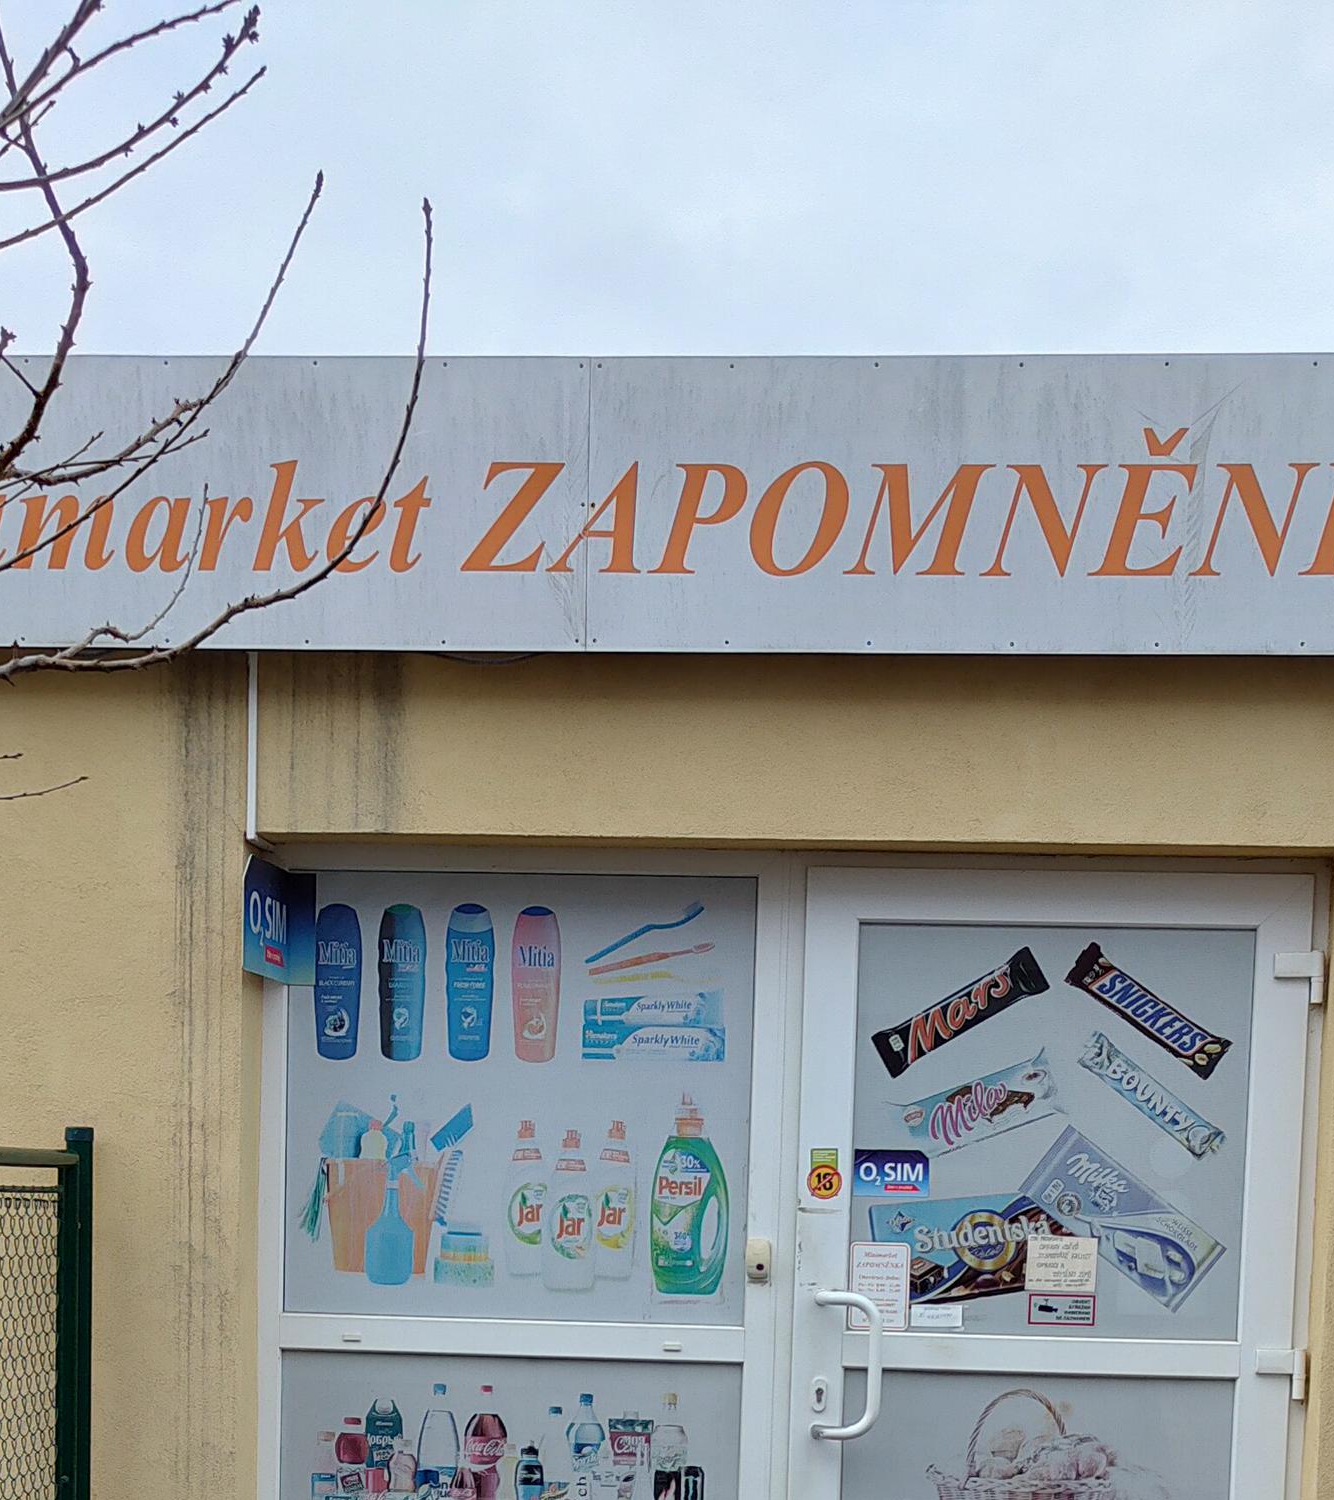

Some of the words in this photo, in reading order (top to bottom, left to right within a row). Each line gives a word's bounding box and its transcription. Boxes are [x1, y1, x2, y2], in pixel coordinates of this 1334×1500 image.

[265, 896, 287, 945] SIM
[382, 938, 420, 963] Mitia
[451, 938, 490, 963] Mitia
[519, 944, 556, 968] Mitia
[636, 1000, 666, 1013] Sparkly
[667, 999, 693, 1010] White
[908, 966, 1011, 1065] Mars
[1096, 972, 1211, 1053] SNICKERS
[632, 1034, 669, 1048] Sparkly
[671, 1034, 701, 1046] White
[1104, 1058, 1198, 1134] BOUNTY
[883, 1162, 924, 1182] SIM
[1066, 1152, 1130, 1194] Milka
[657, 1175, 702, 1197] Persil
[517, 1203, 543, 1227] Jar
[556, 1214, 585, 1241] Jar
[597, 1205, 623, 1227] Jar
[913, 1212, 1050, 1254] Studentská
